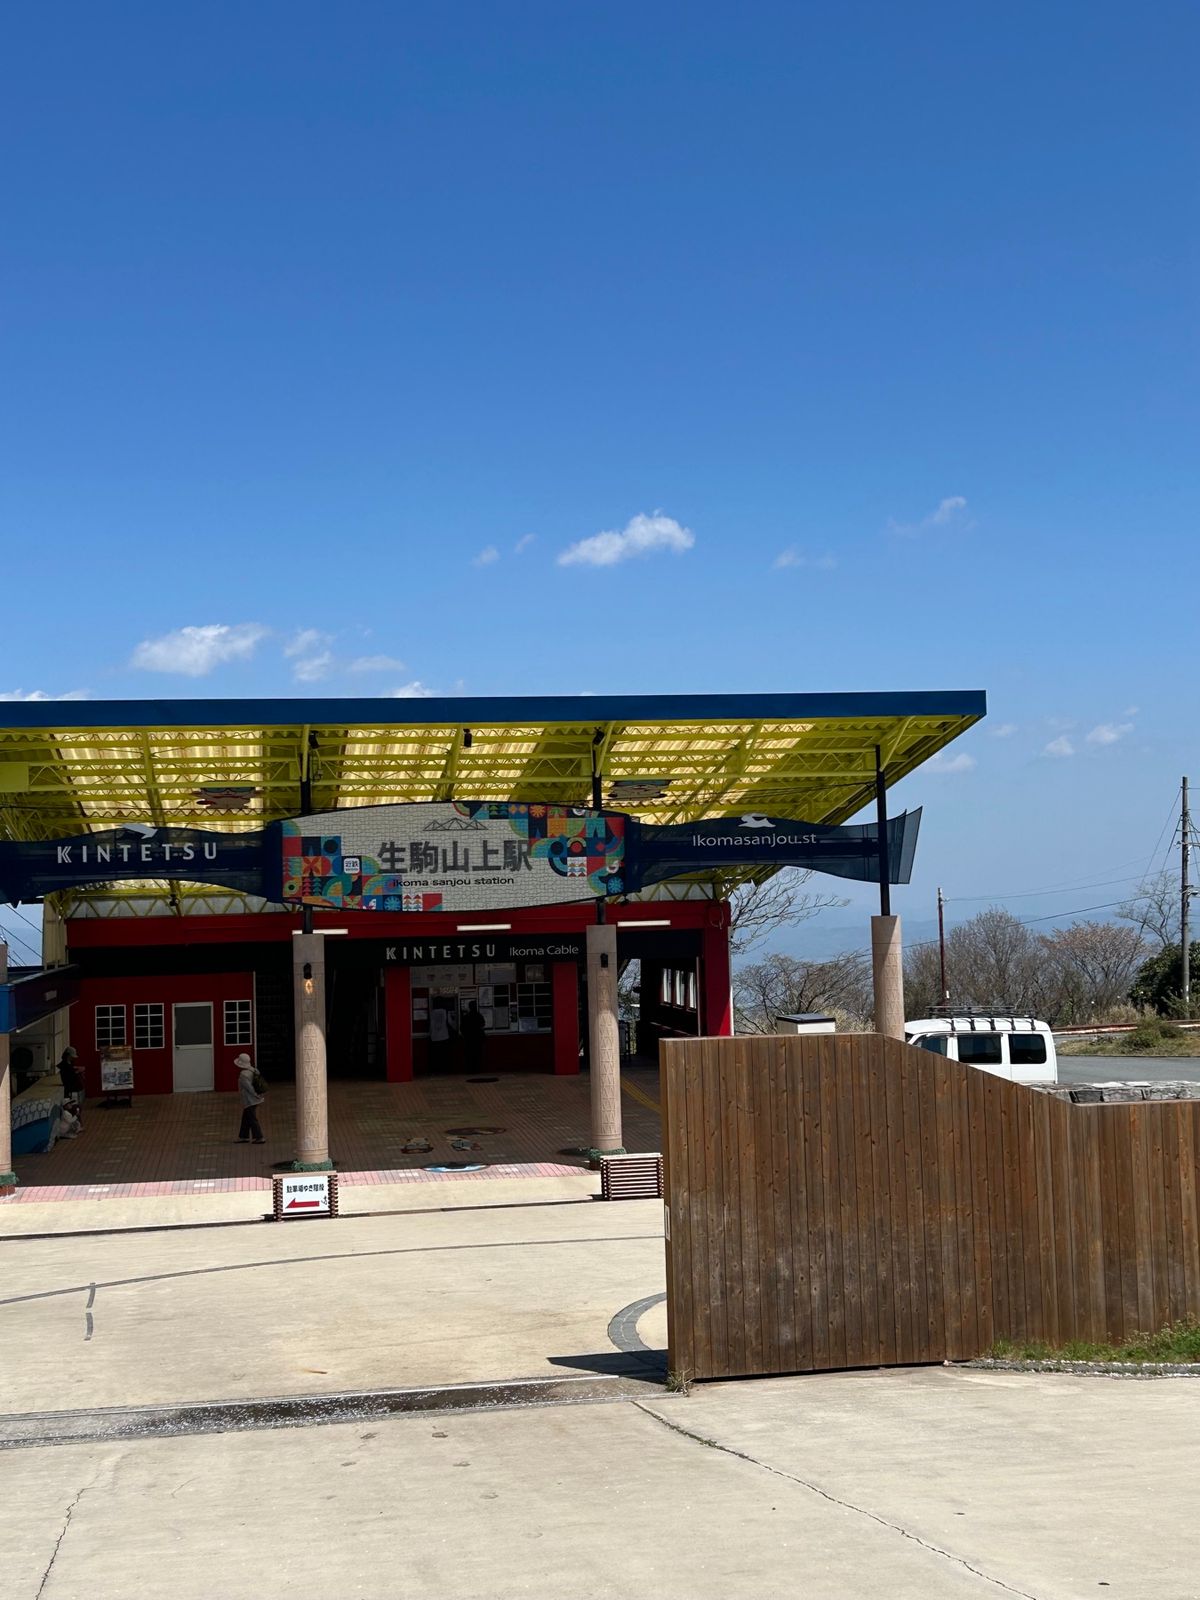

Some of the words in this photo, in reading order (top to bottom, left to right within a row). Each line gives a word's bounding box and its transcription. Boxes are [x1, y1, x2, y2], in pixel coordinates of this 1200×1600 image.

[57, 842, 218, 863] KINTETSU
[378, 840, 532, 873] 生駒山上駅
[393, 879, 429, 887] ikoma
[432, 878, 471, 888] sanjou
[474, 877, 515, 886] station
[386, 944, 495, 960] KINTETSU
[510, 946, 544, 957] Ikoma
[546, 945, 579, 955] Cable
